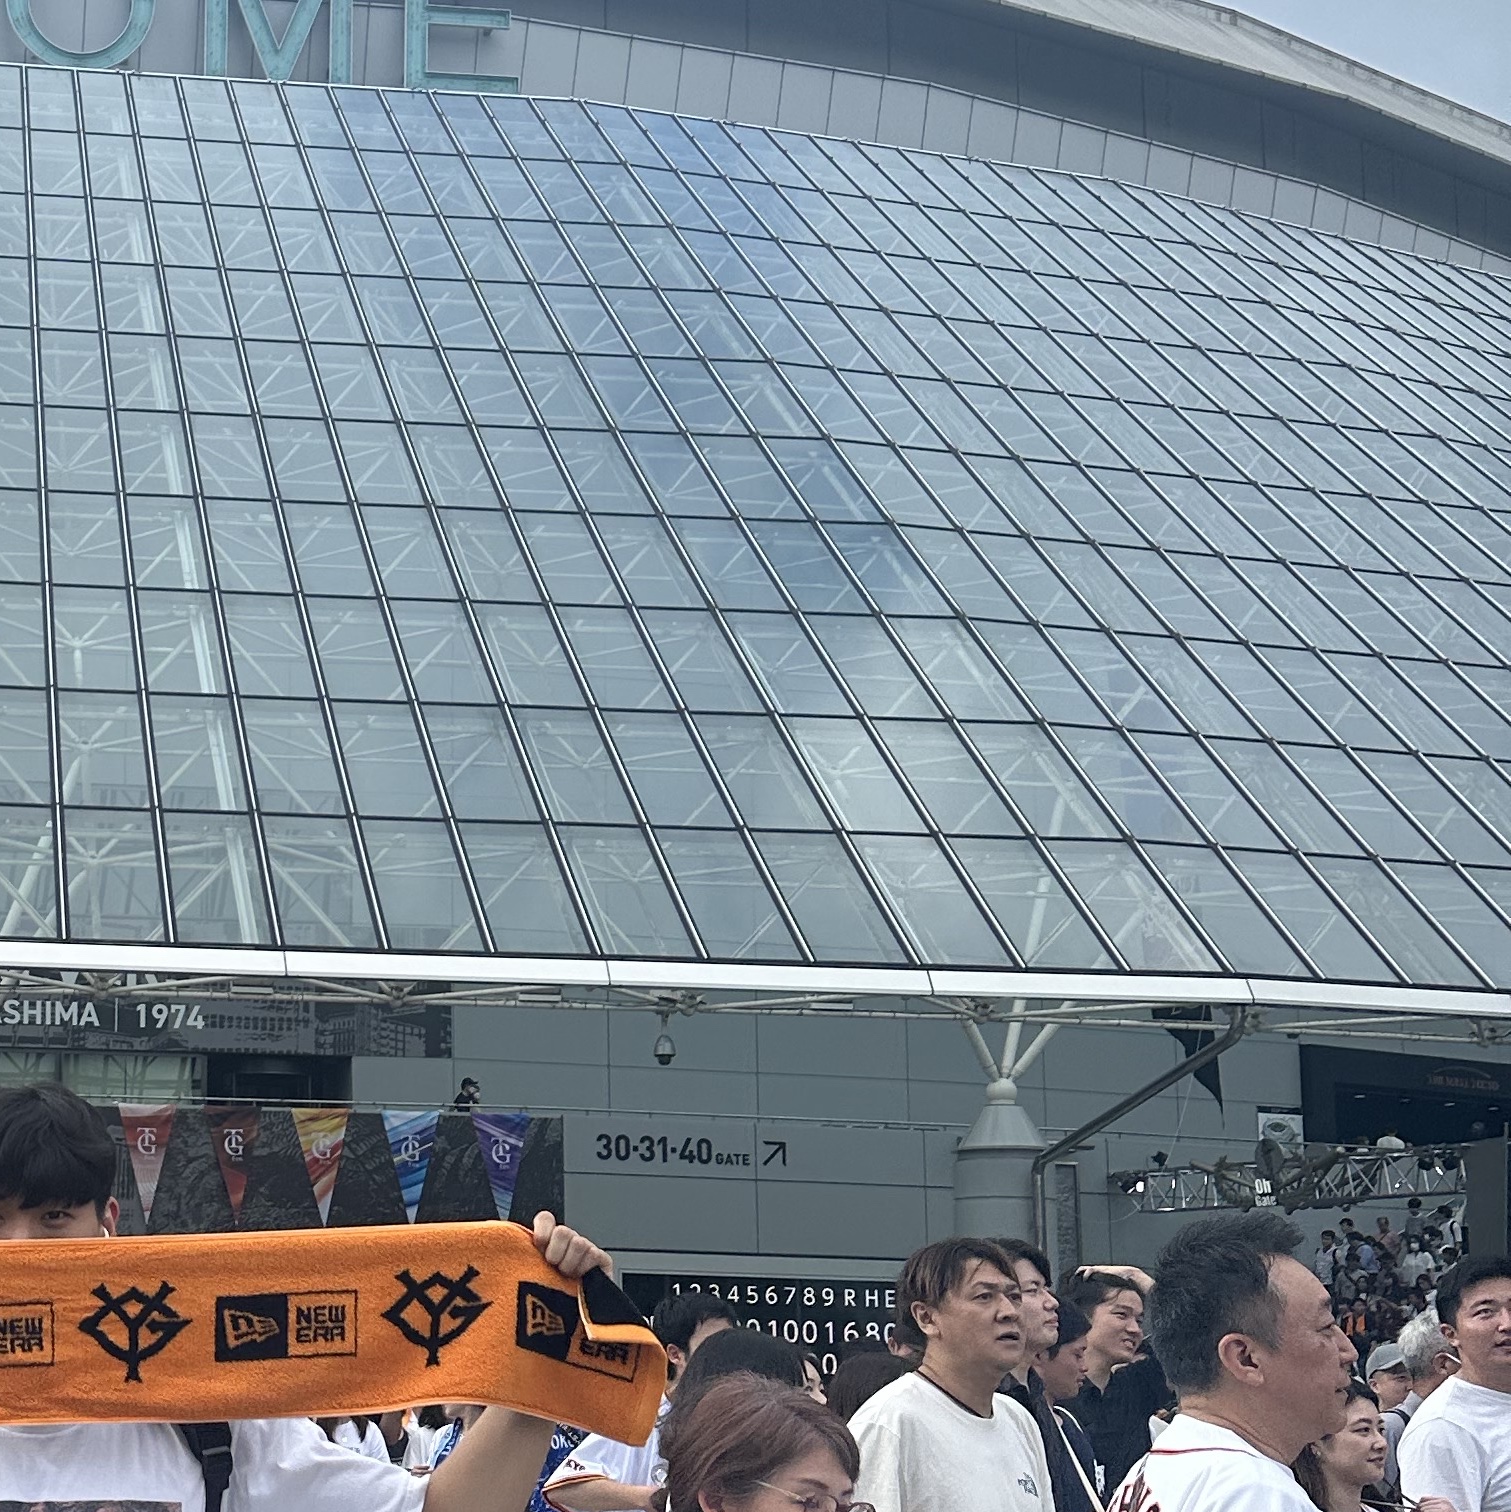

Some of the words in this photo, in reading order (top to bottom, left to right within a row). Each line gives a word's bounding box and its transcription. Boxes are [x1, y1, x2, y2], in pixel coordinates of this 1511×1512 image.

[136, 1003, 205, 1031] 1974
[715, 1153, 751, 1166] GATE
[295, 1304, 346, 1325] NEW
[295, 1325, 346, 1344] ERA
